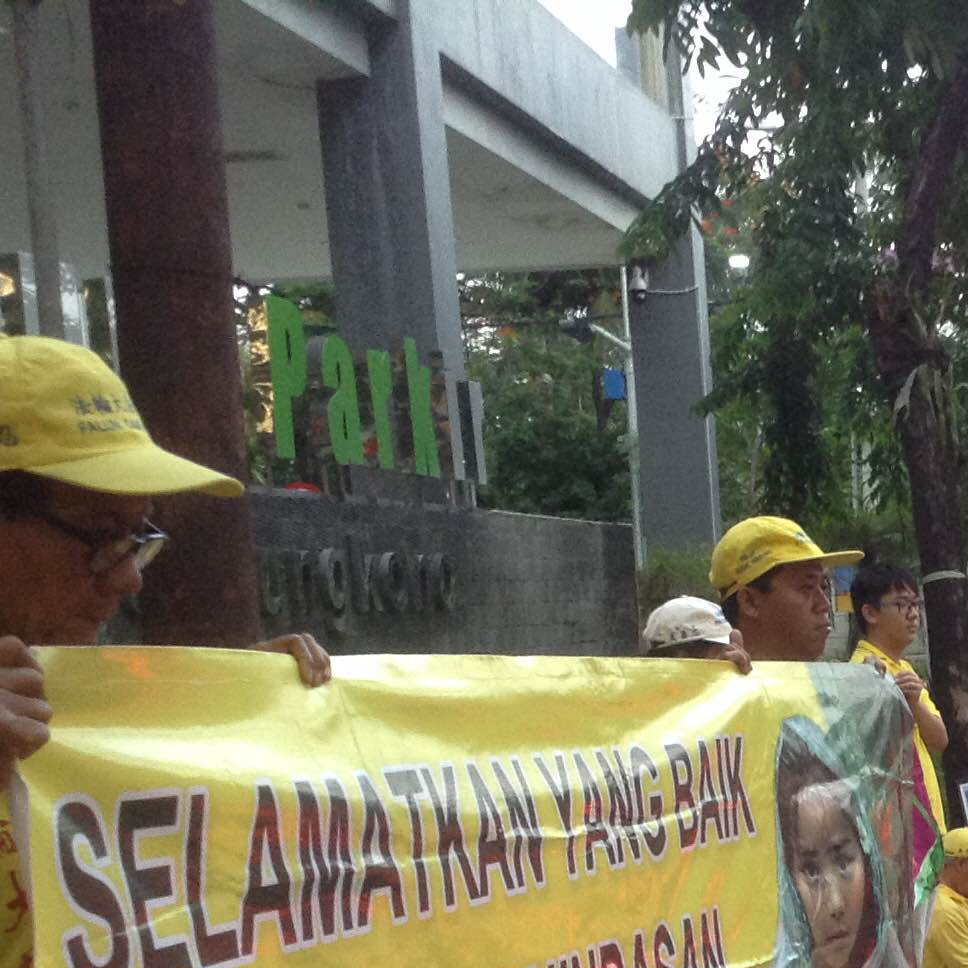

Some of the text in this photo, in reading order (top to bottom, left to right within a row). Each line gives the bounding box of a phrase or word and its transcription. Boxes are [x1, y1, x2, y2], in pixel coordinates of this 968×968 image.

[266, 294, 441, 478] Park
[534, 742, 666, 879] YANG
[664, 734, 757, 853] BAIK
